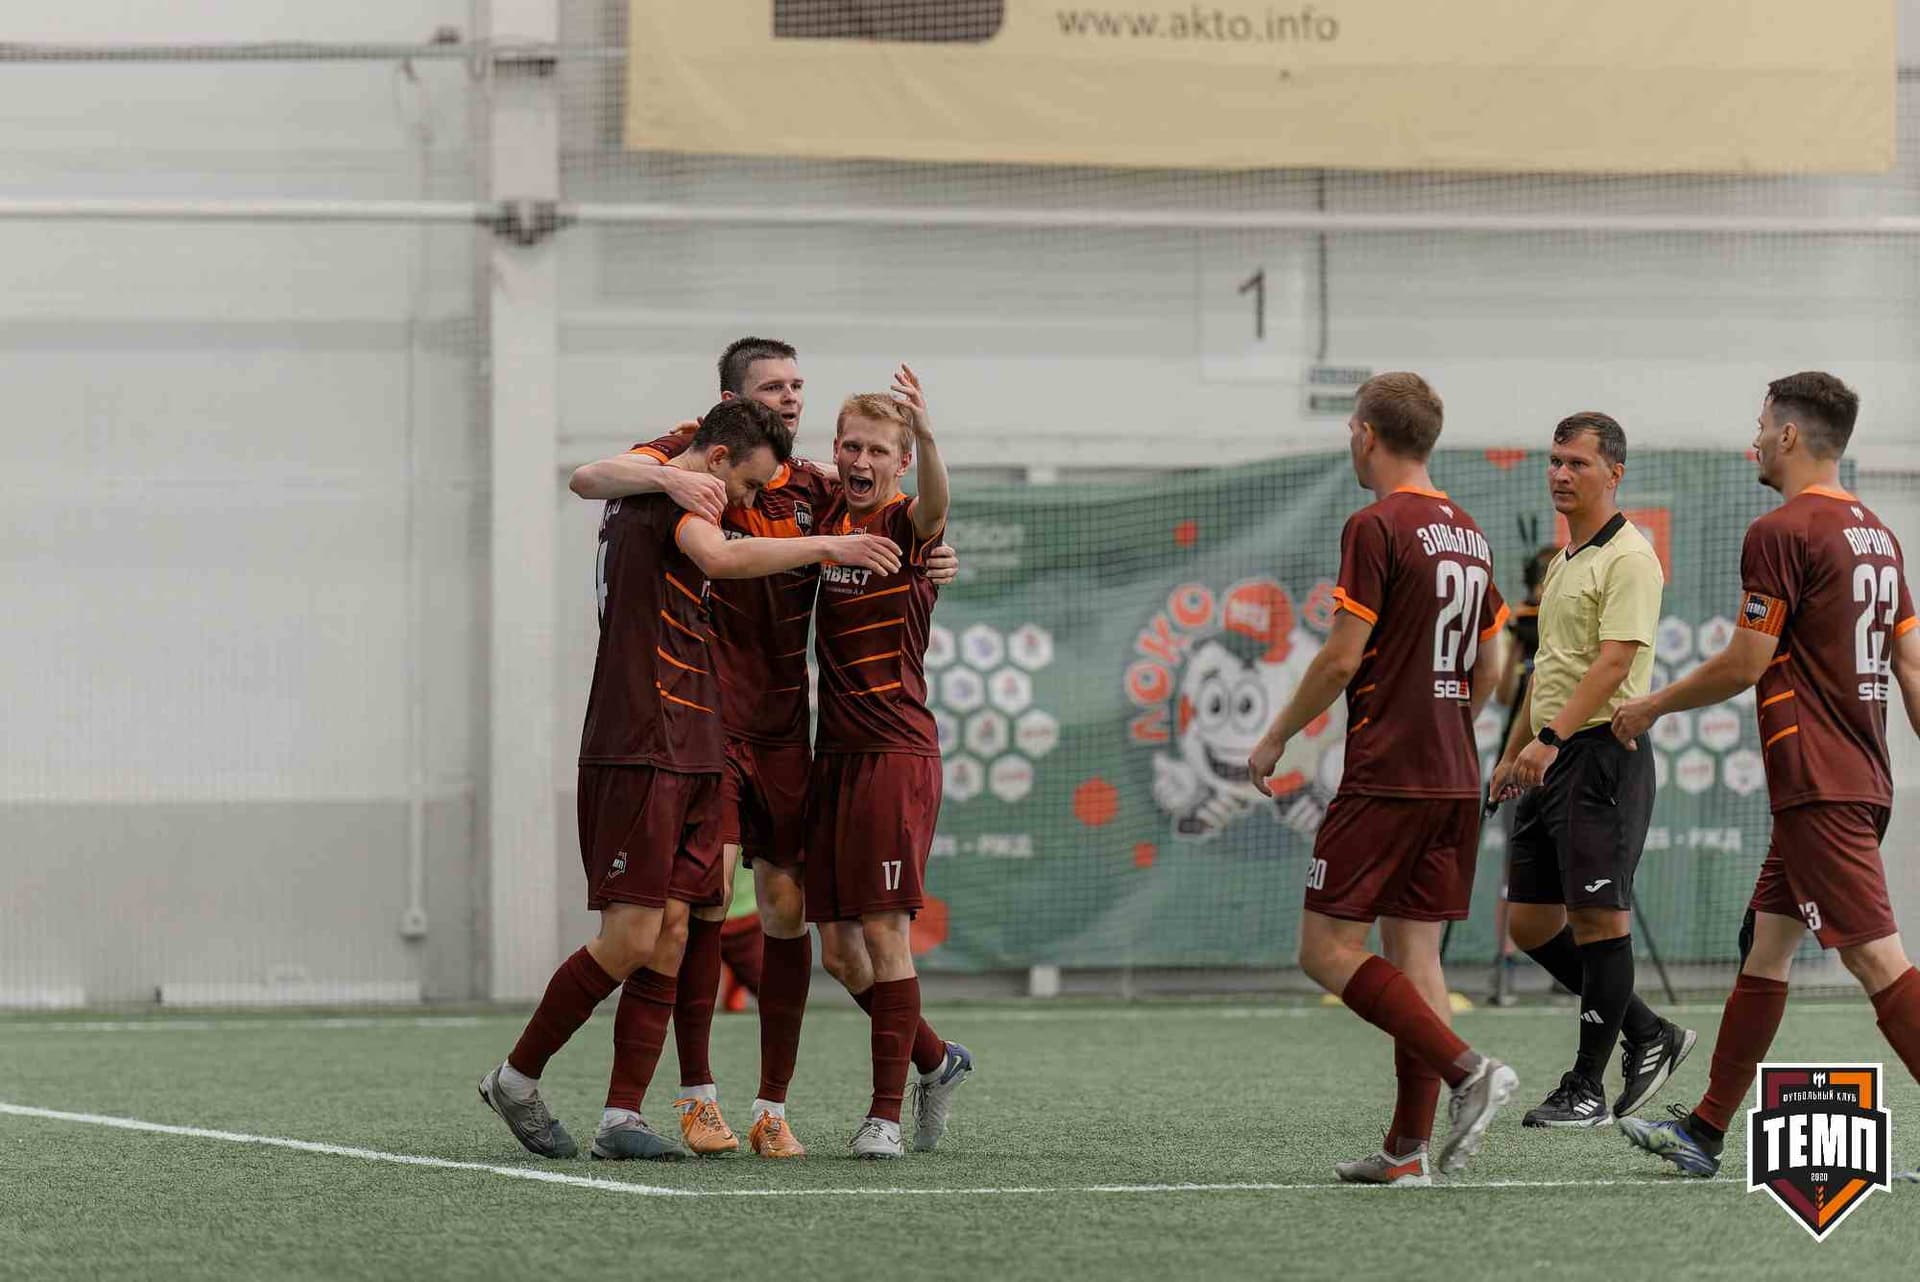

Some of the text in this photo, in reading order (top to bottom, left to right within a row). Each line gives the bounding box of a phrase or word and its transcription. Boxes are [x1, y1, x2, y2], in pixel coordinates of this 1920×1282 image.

[1056, 5, 1340, 42] www.akto.info
[1237, 266, 1265, 339] 1
[1433, 560, 1489, 672] 20
[1853, 564, 1899, 674] 23
[881, 860, 903, 890] 17
